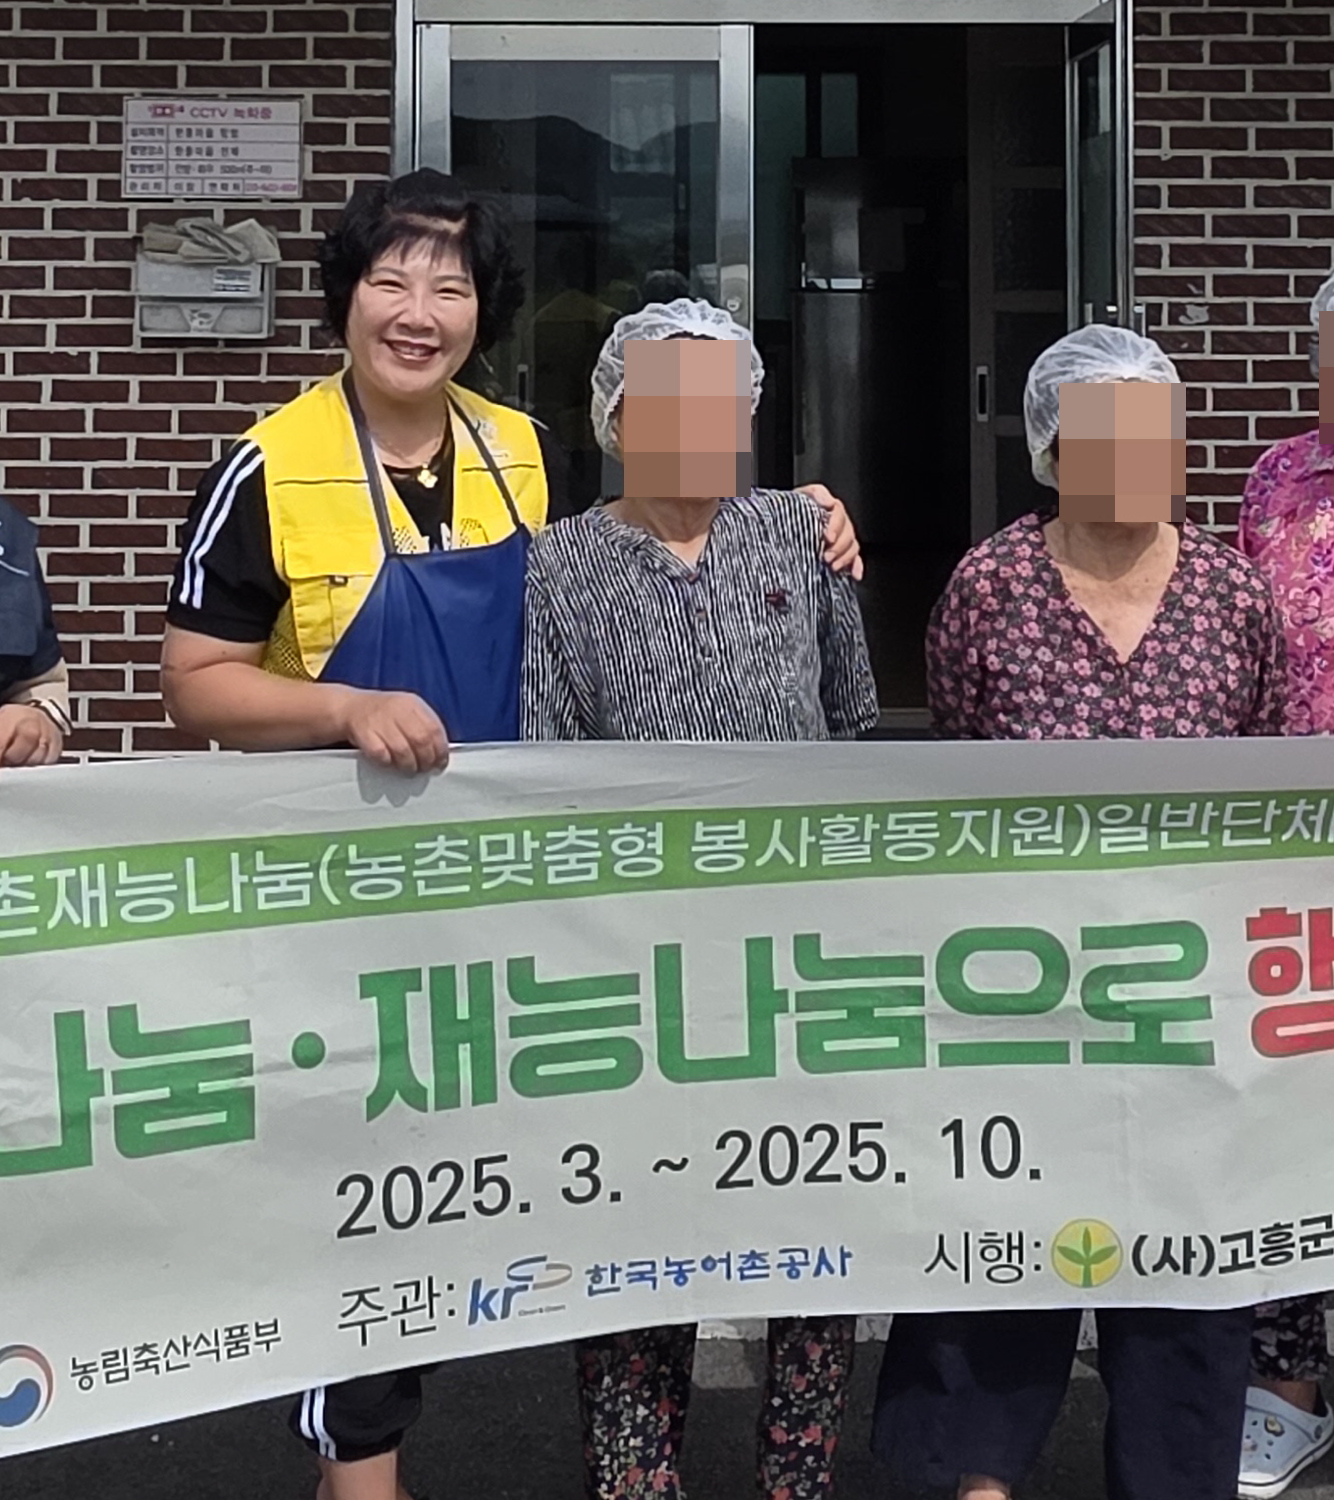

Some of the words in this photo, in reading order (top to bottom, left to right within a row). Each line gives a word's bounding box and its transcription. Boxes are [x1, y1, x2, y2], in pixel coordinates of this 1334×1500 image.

[189, 106, 228, 118] CCTV
[335, 1155, 531, 1238] 2025.
[561, 1143, 621, 1204] 3.
[714, 1121, 907, 1190] 2025.
[941, 1116, 1042, 1181] 10.
[924, 1230, 1043, 1285] 시행:
[337, 1275, 455, 1347] 주관:
[584, 1246, 853, 1296] 한국농어촌공사
[69, 1318, 282, 1391] 농림축산식품부
